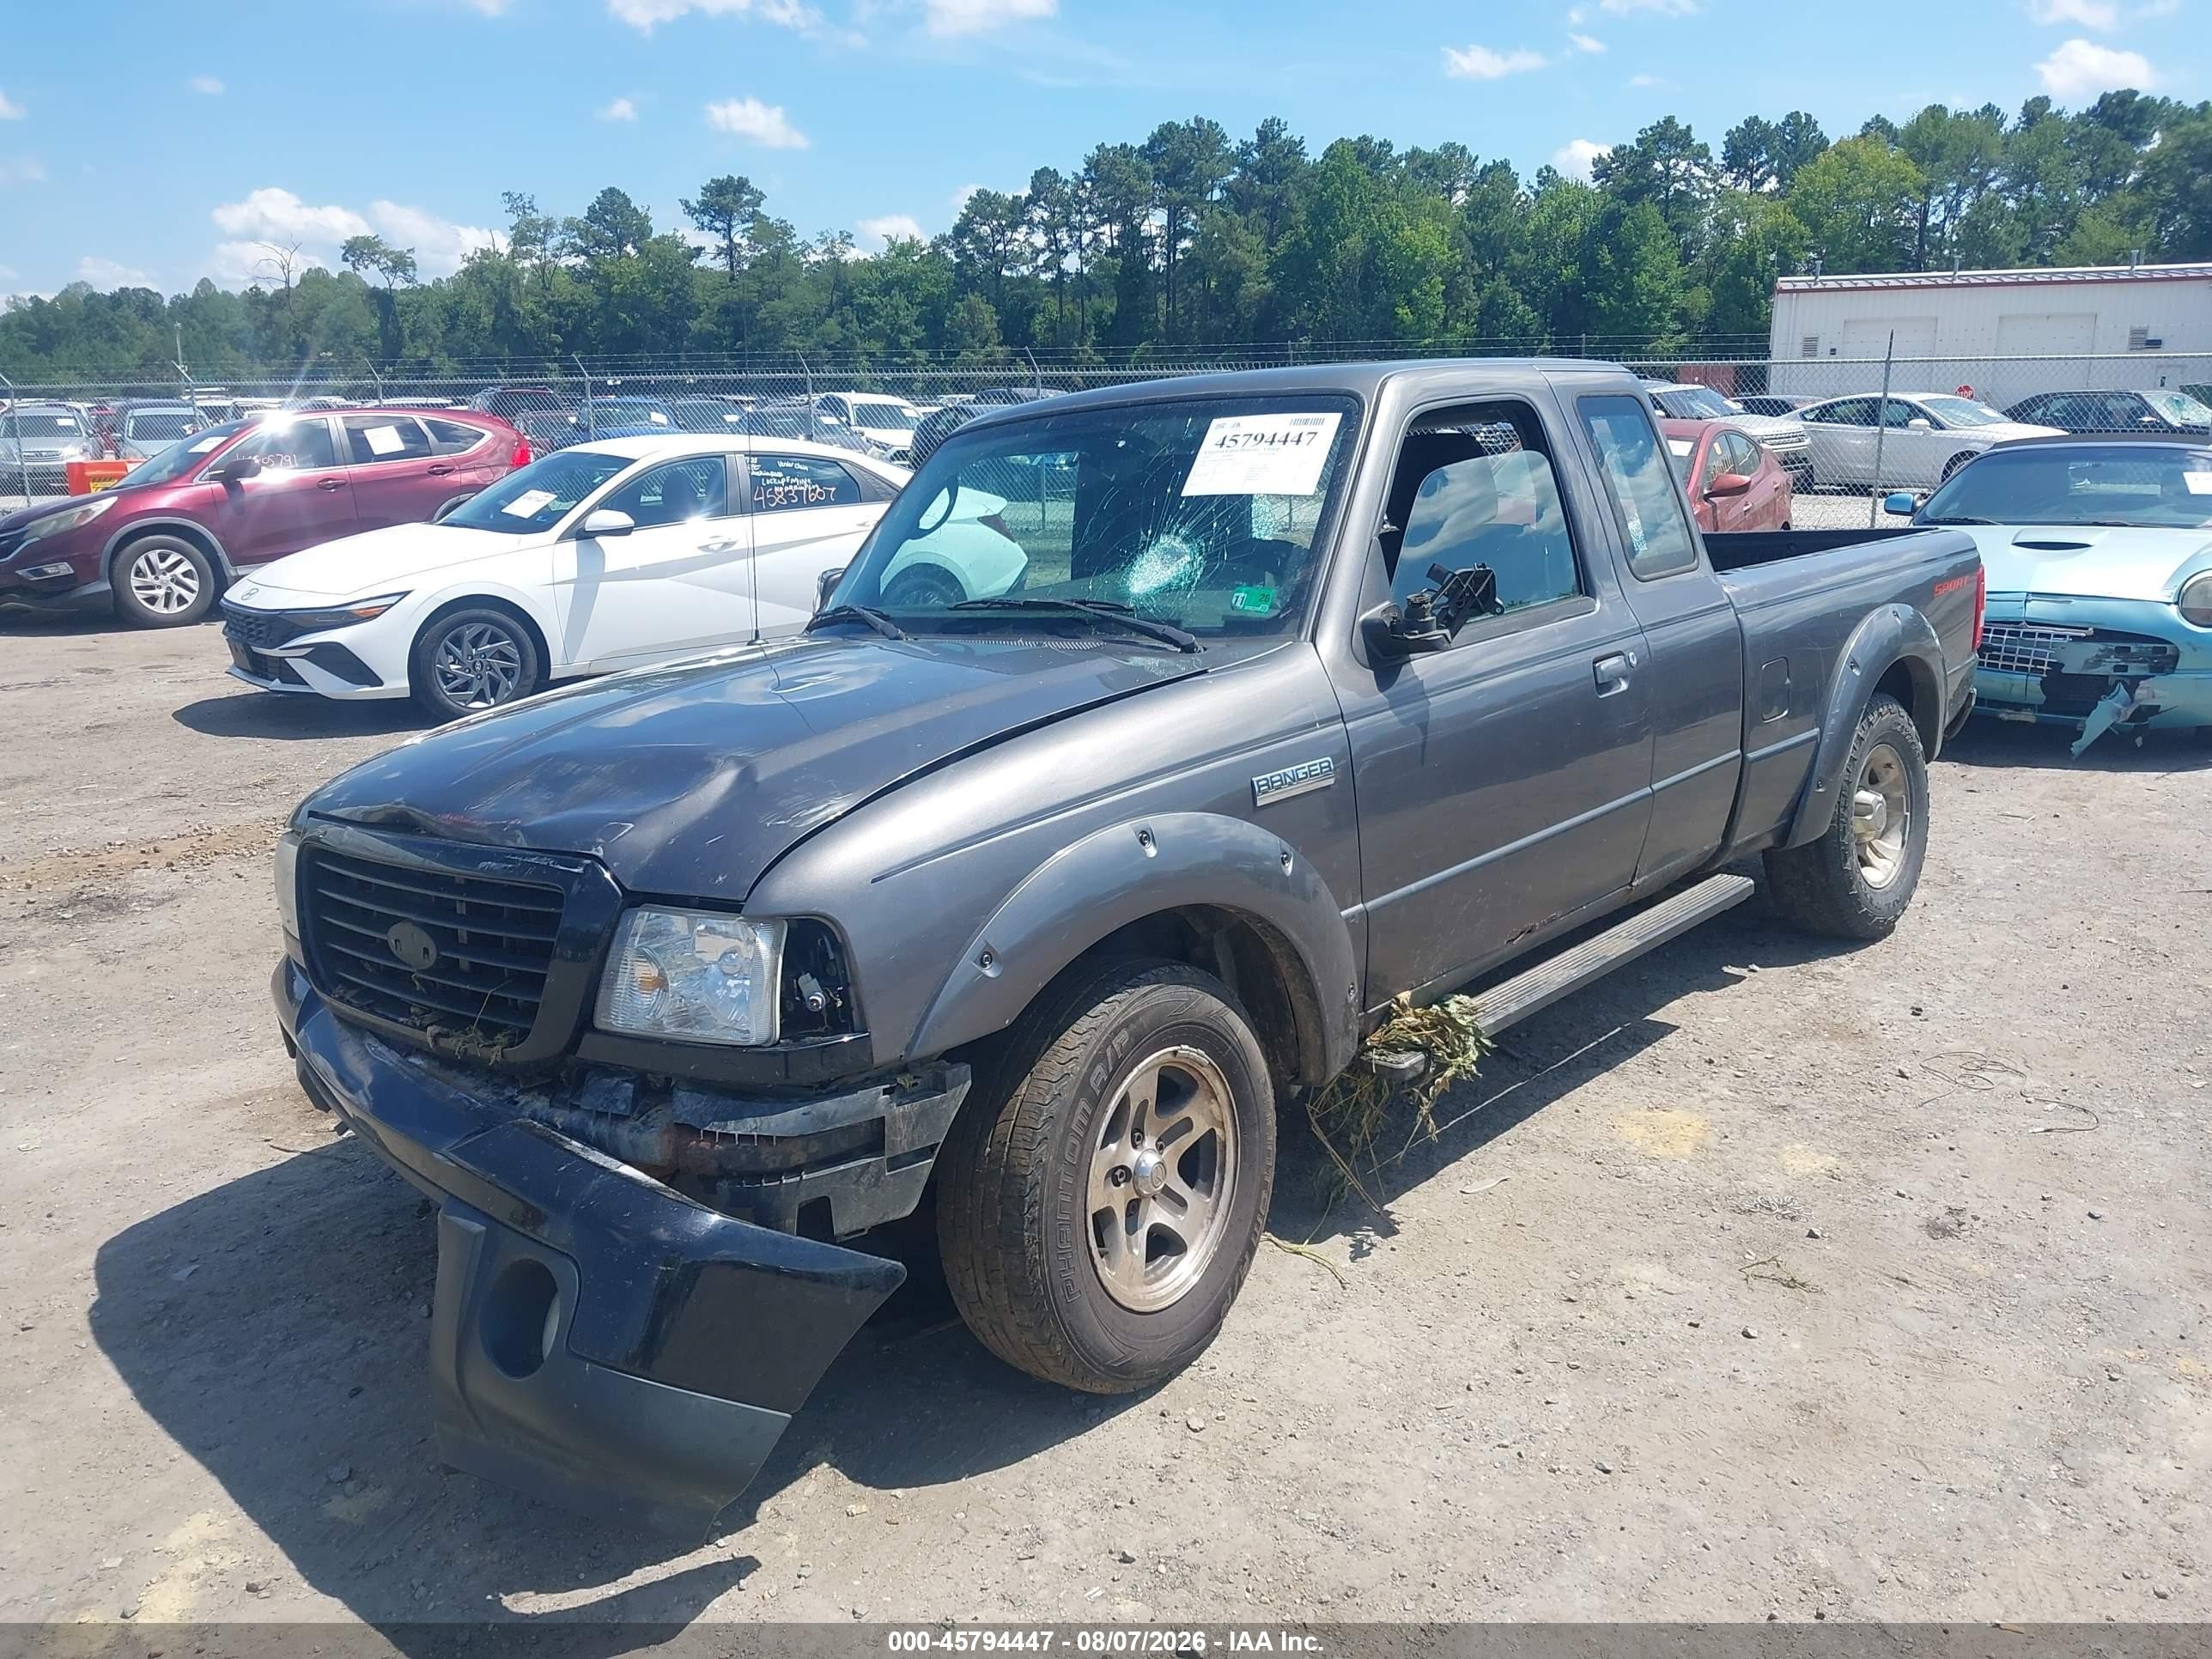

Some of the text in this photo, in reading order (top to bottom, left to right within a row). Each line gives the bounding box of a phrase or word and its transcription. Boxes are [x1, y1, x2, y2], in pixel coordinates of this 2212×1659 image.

[1214, 431, 1319, 448] 45794447
[1934, 575, 1971, 598] SPORT
[1234, 595, 1245, 606] 11
[1255, 759, 1334, 796] RANGER
[1057, 1028, 1130, 1304] PHANTOM A/P
